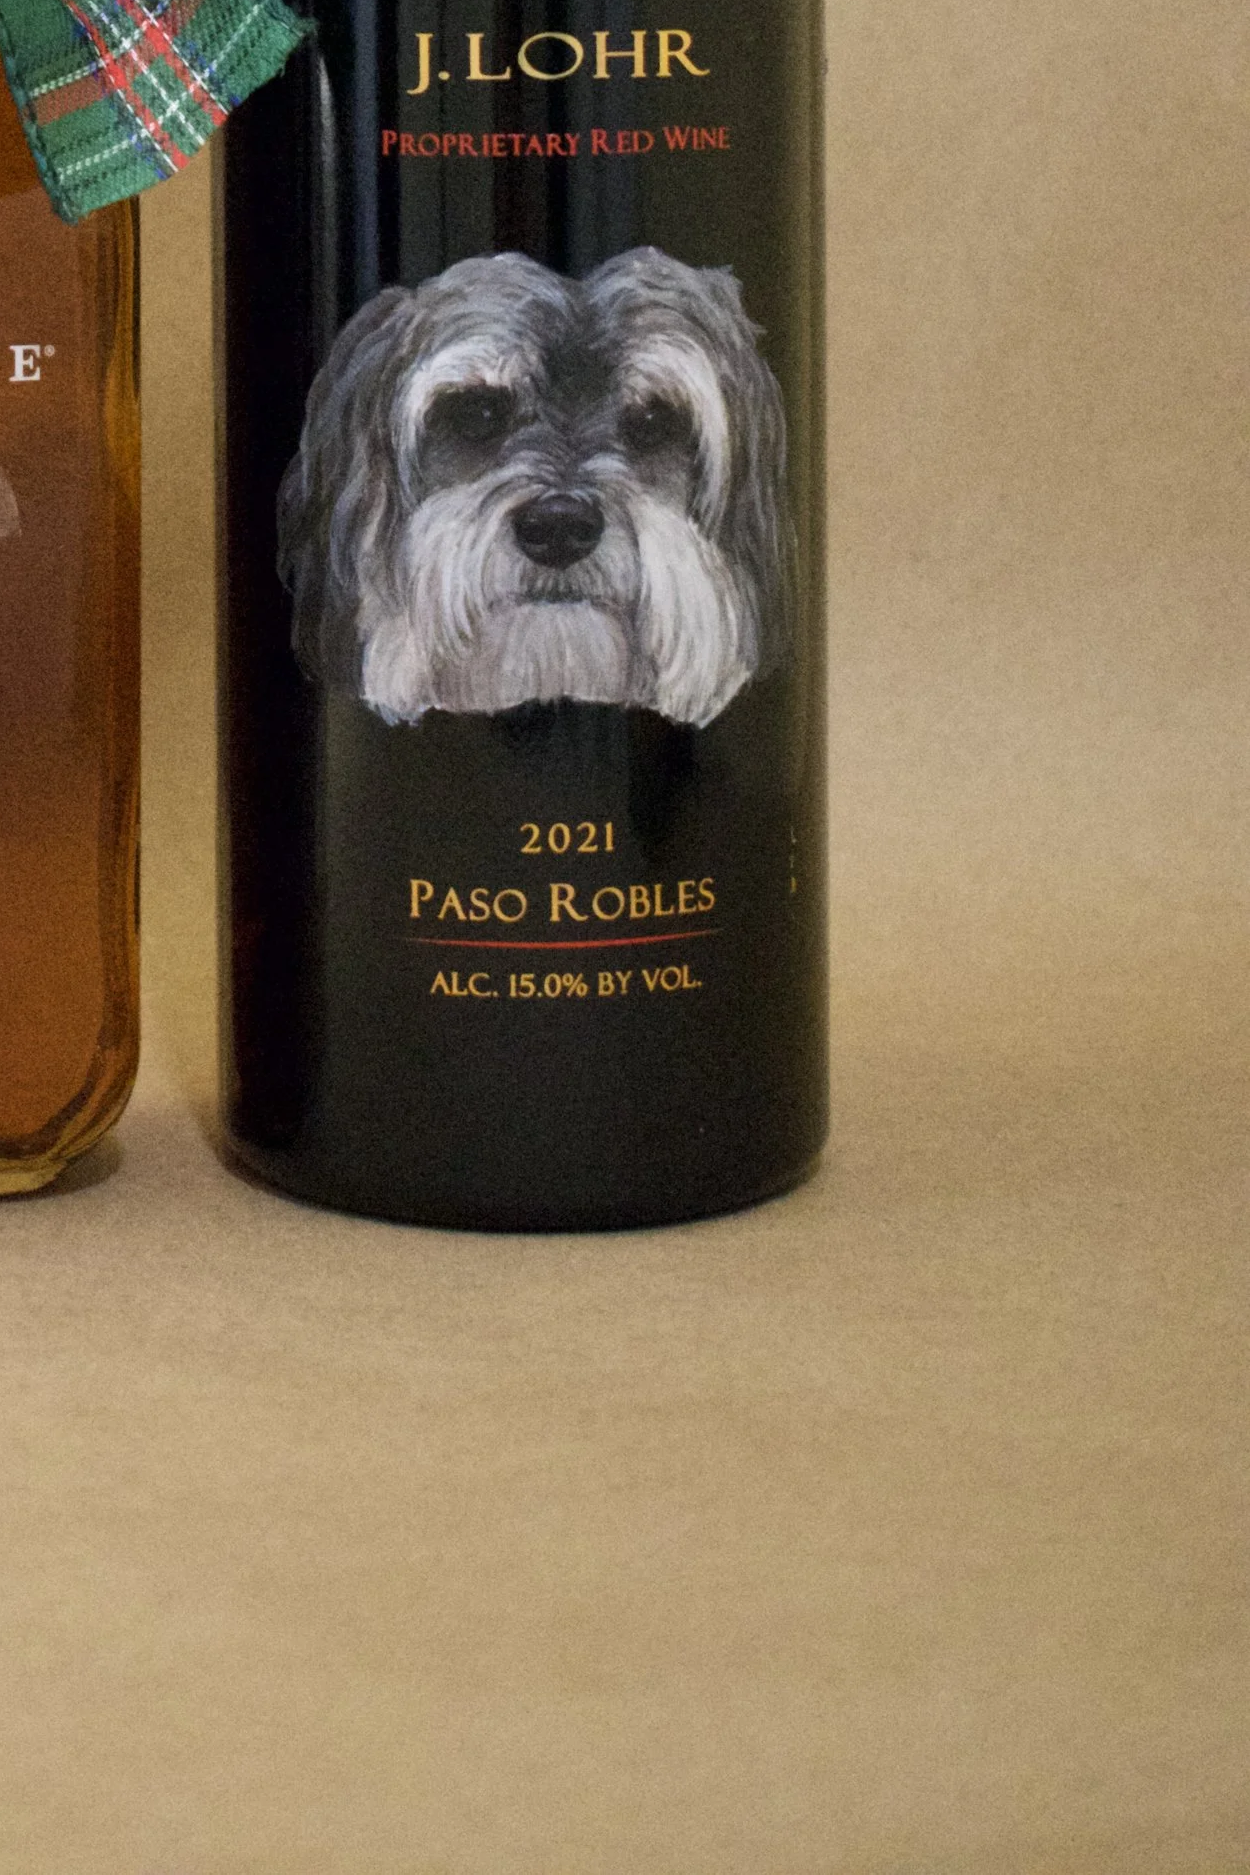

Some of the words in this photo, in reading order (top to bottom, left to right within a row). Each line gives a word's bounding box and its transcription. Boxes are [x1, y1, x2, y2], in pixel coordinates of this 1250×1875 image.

[381, 129, 581, 158] PROPRIETARY
[591, 127, 655, 155] RED
[662, 125, 731, 151] WINE
[519, 821, 616, 855] 2021
[409, 878, 529, 923] PASO
[550, 877, 717, 922] ROBLES
[430, 971, 498, 998] ALC.
[508, 972, 588, 998] 15.0%
[598, 970, 633, 995] BY
[642, 966, 703, 992] VOL.
